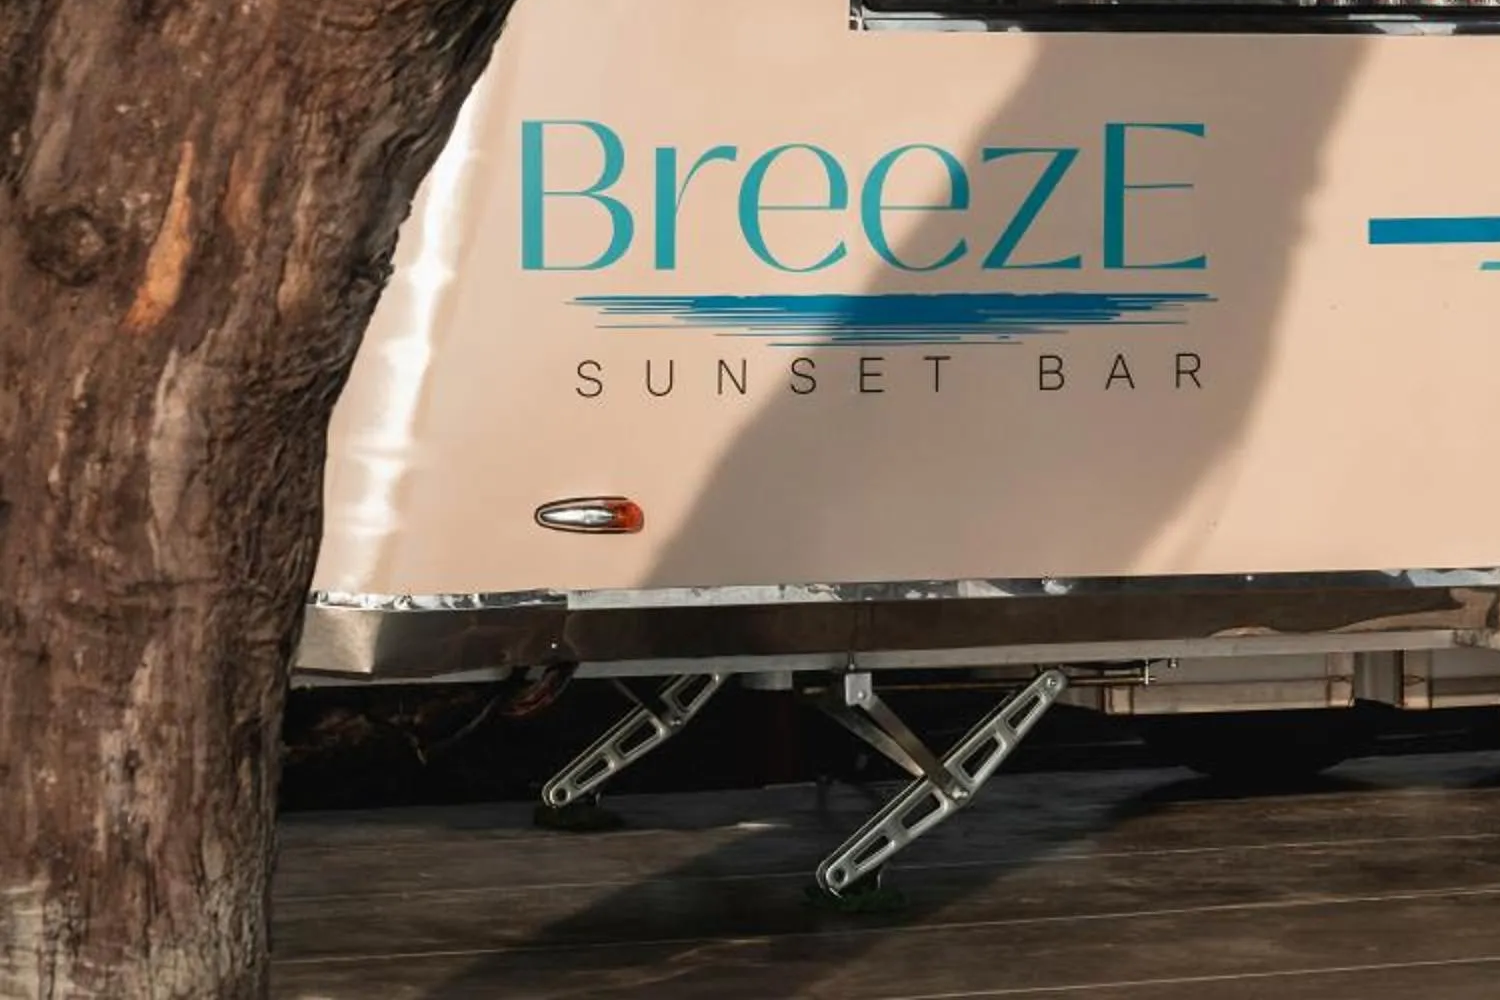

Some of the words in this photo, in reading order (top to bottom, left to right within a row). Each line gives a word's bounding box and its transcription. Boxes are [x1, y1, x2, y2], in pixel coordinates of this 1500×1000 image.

[521, 119, 1208, 271] BreezE
[575, 355, 951, 398] SUNSET
[1038, 352, 1202, 390] BAR
